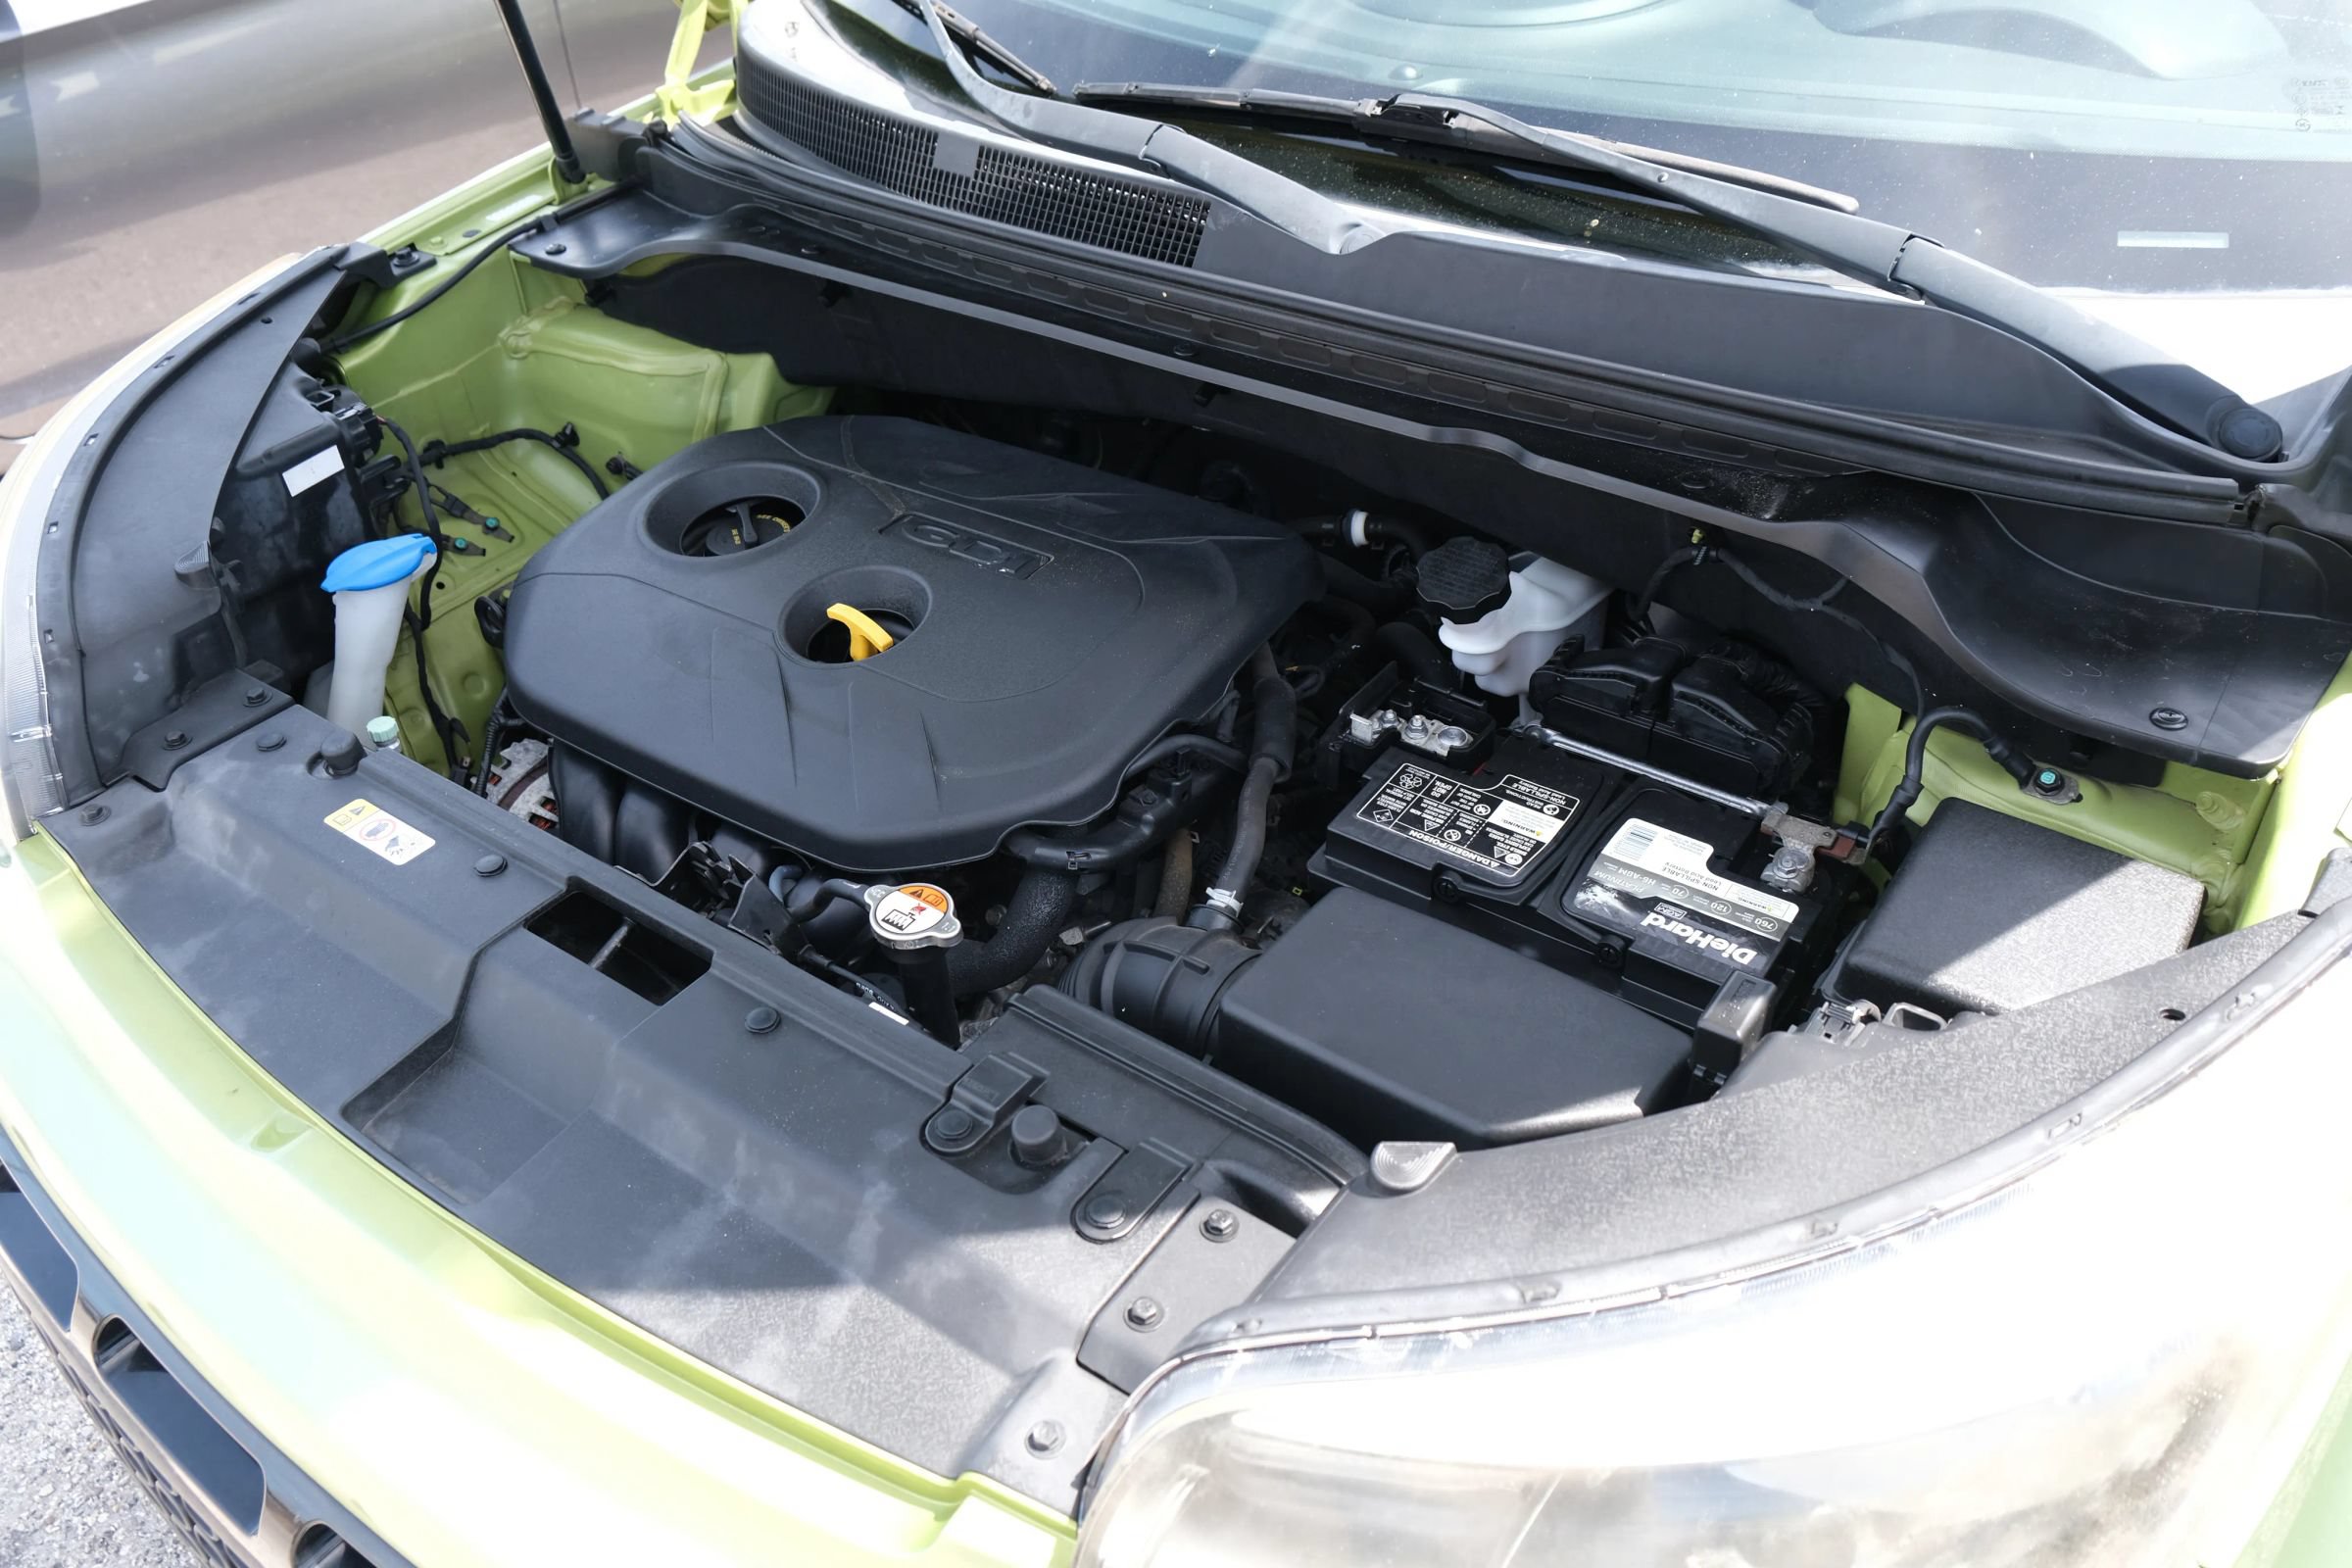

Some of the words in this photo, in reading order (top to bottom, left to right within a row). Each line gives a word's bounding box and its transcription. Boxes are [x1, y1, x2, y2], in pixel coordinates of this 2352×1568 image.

[901, 523, 1034, 575] GDI
[1433, 780, 1452, 790] OPEN.
[1433, 785, 1446, 794] NOT
[1512, 782, 1566, 805] NON-SPILLABLE
[1409, 829, 1492, 866] DANGER/POISON
[1592, 870, 1644, 892] PLATINUM
[1660, 865, 1719, 891] NON-SPILLABLE
[1671, 887, 1685, 896] 70
[1709, 902, 1728, 912] 120
[1753, 917, 1774, 929] 760
[1641, 911, 1757, 964] DieHard
